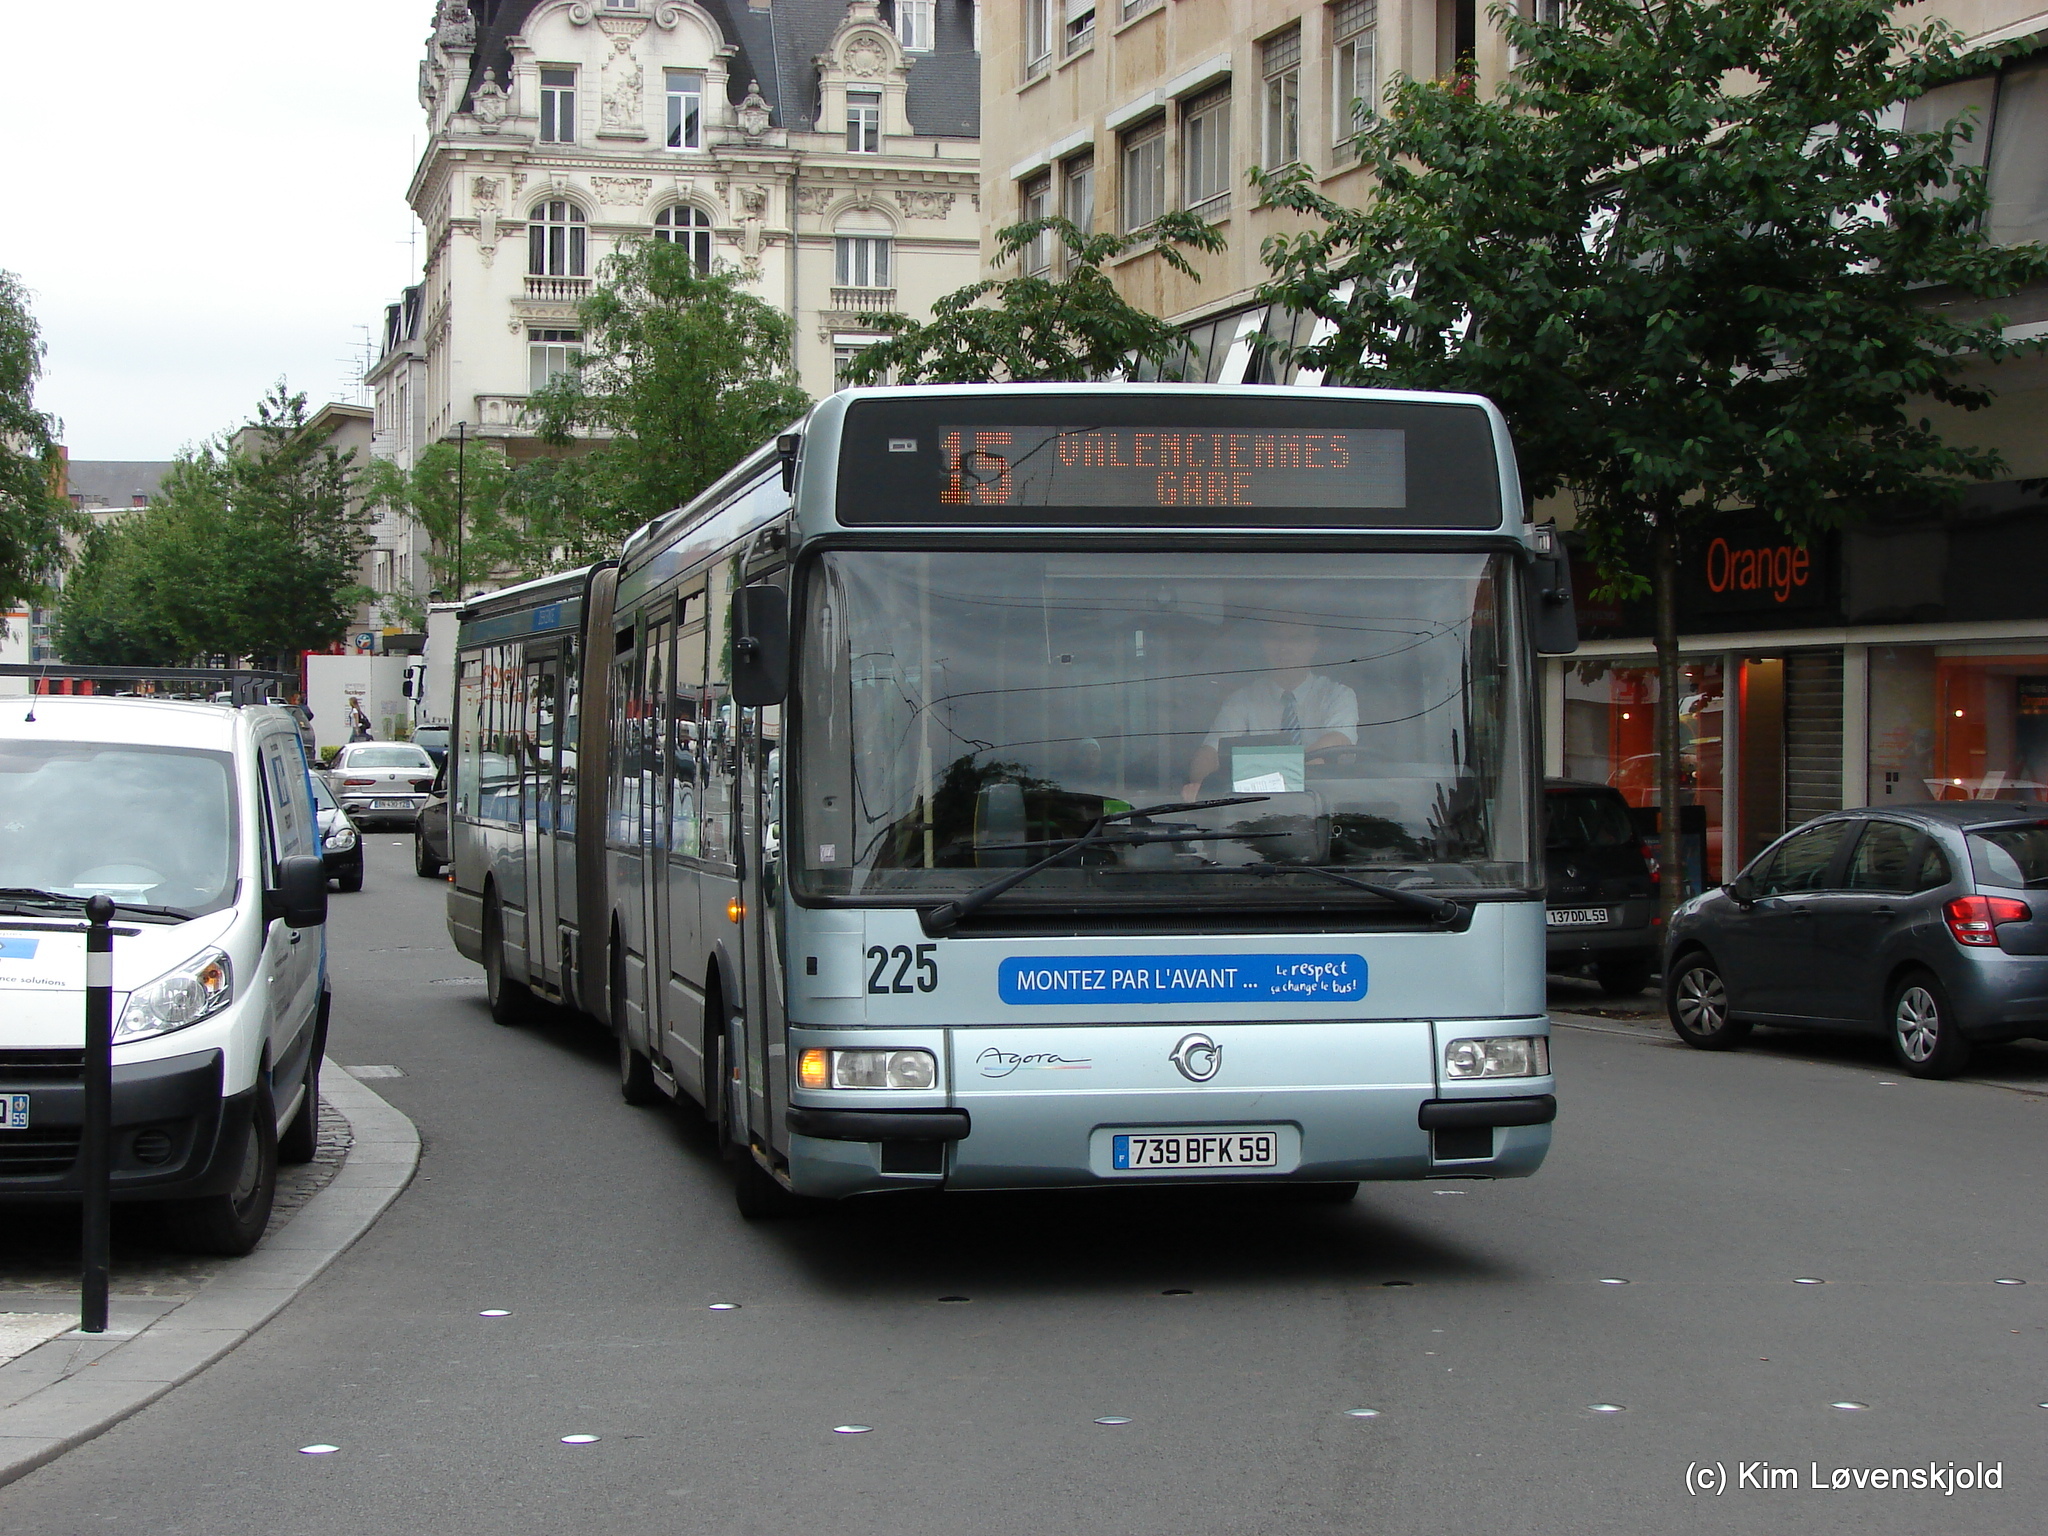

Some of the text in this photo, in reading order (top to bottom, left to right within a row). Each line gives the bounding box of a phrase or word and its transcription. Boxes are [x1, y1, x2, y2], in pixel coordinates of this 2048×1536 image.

[940, 431, 1349, 504] 15 VALENCIENNES
[1158, 471, 1252, 505] GARE
[1707, 537, 1810, 603] Orange
[21, 976, 66, 987] solutions
[867, 943, 938, 995] 225
[1017, 969, 1106, 990] MONTEZ
[1112, 969, 1149, 990] PAR
[1155, 968, 1238, 989] L'AVANT
[1276, 961, 1347, 982] Le respect
[1282, 980, 1317, 995] change
[1320, 981, 1329, 991] le
[1332, 979, 1357, 993] bus!
[975, 1047, 1092, 1078] Agora
[13, 1113, 26, 1125] 59
[1133, 1138, 1180, 1164] 739
[1186, 1138, 1233, 1163] BFK
[1239, 1137, 1270, 1162] 59
